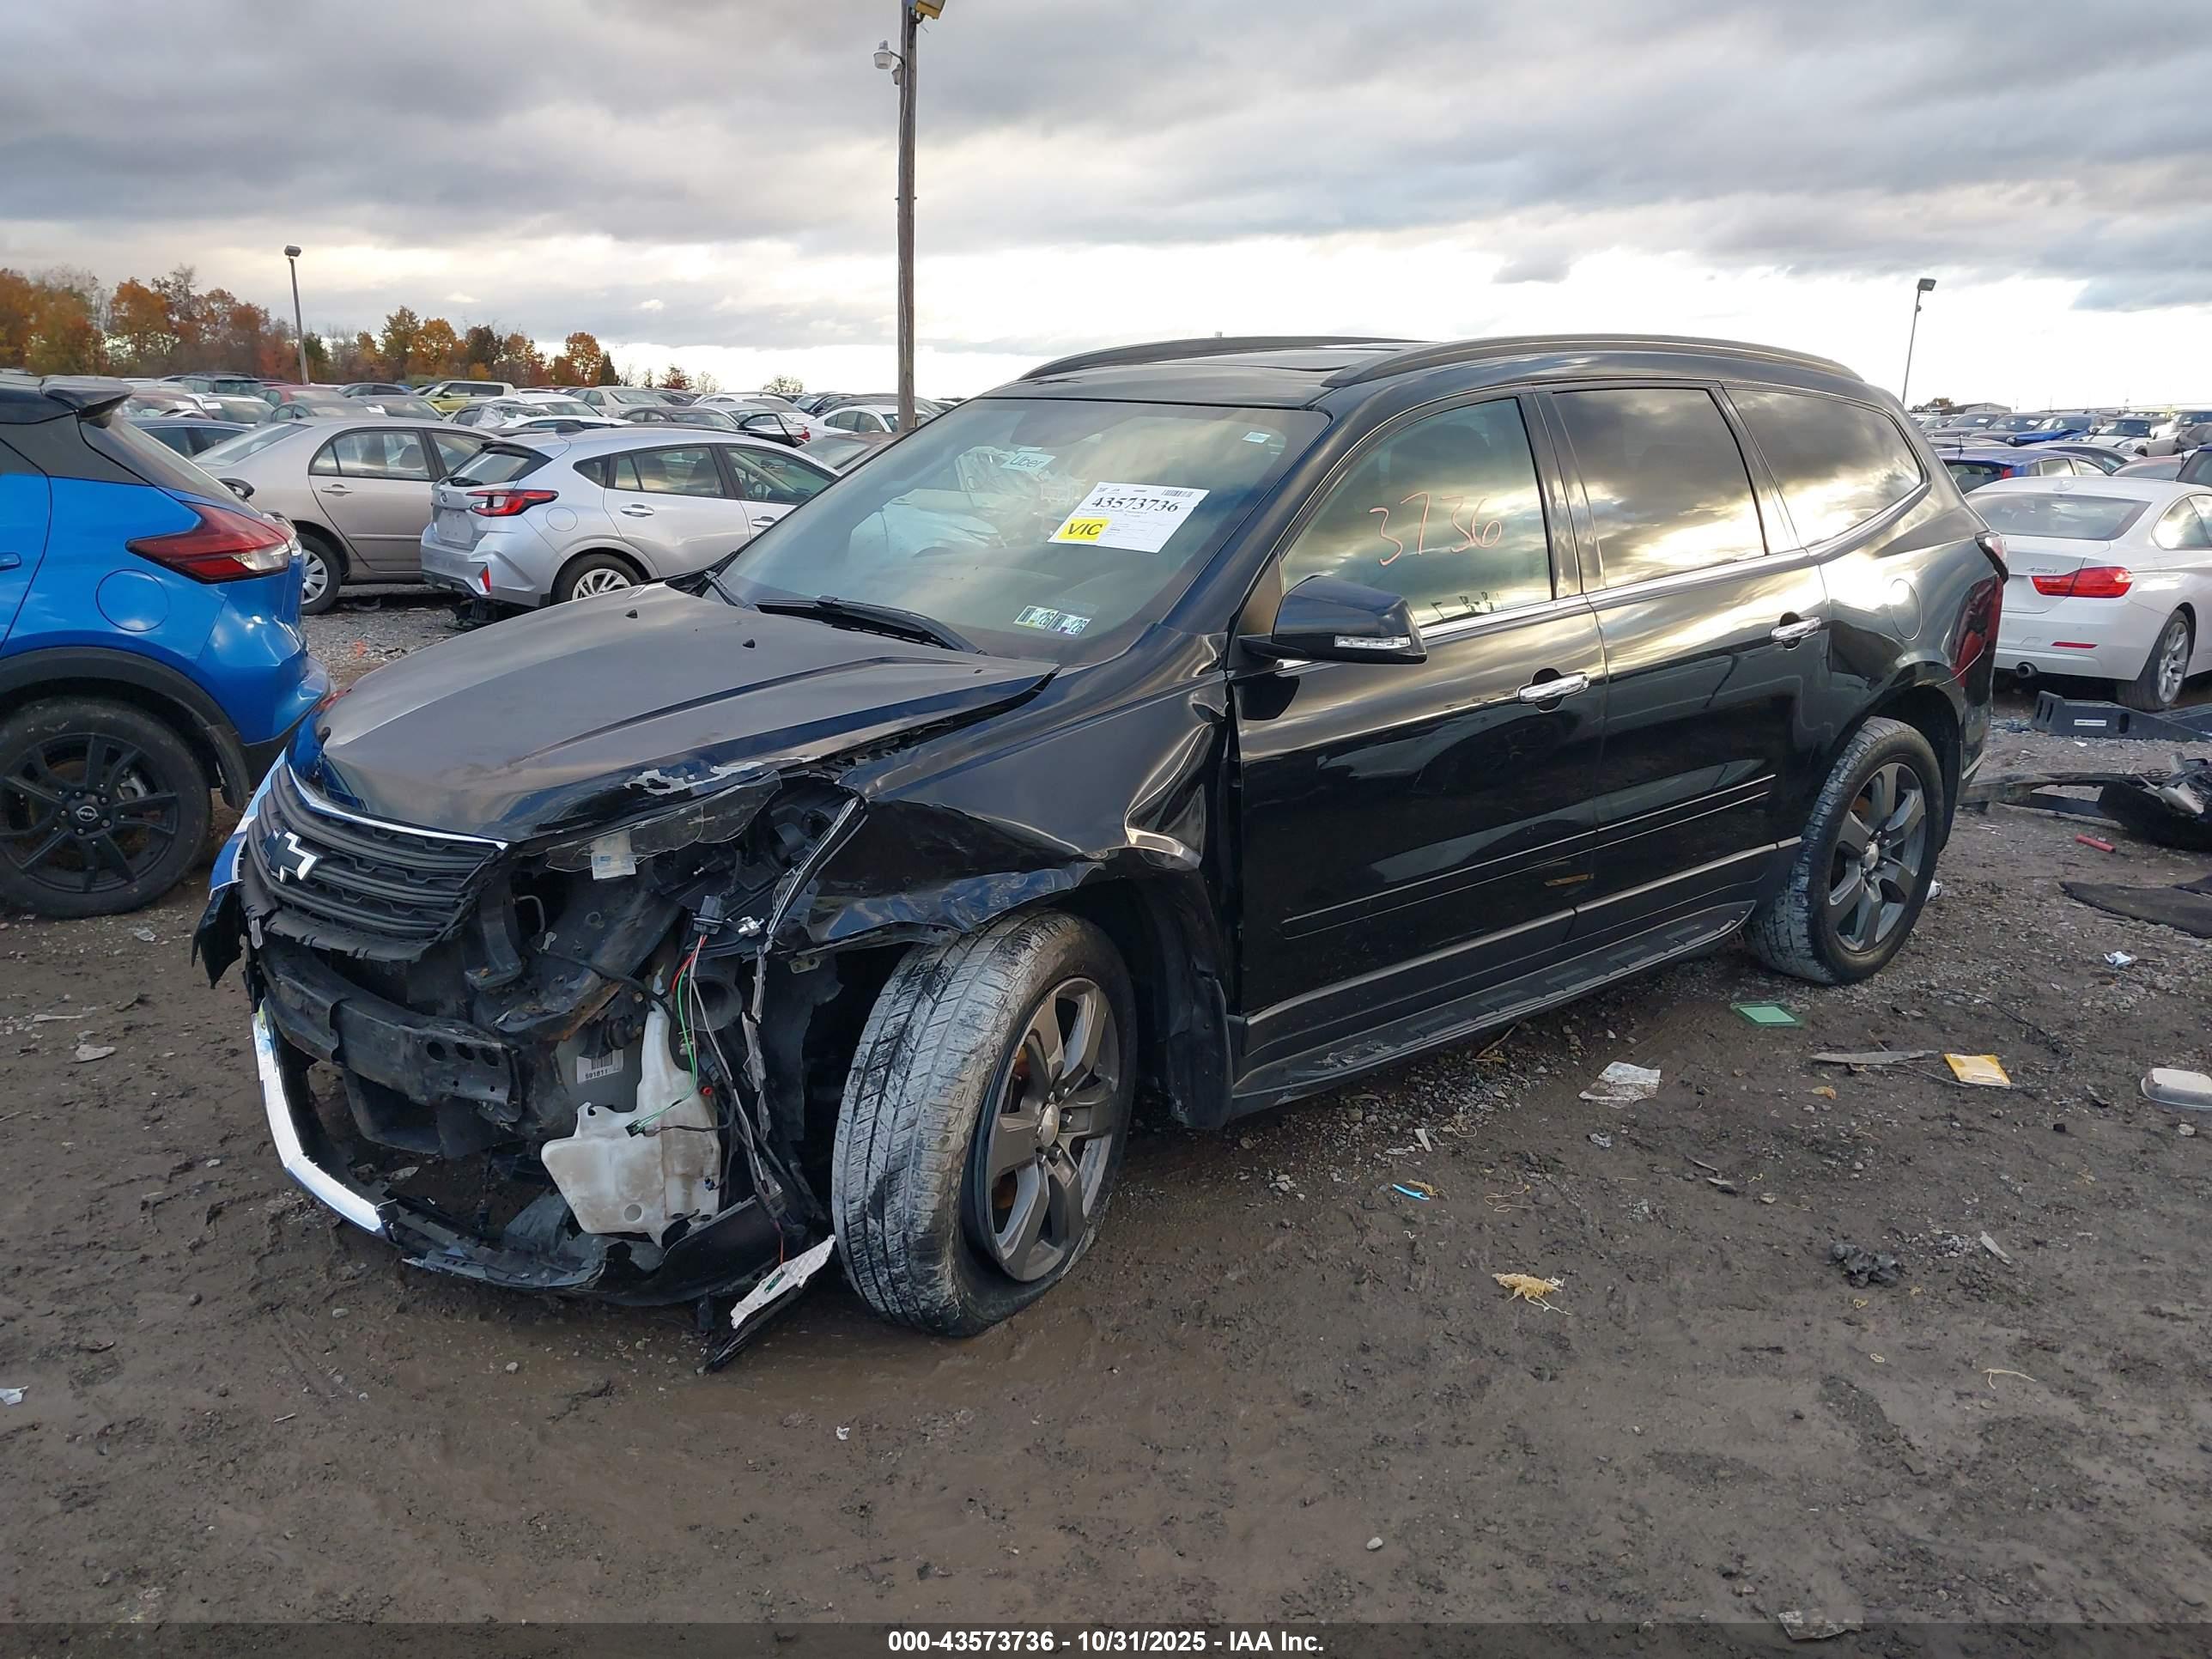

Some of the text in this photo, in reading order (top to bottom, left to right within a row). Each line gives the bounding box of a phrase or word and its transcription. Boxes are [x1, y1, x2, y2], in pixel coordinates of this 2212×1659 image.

[1010, 454, 1044, 468] Uber
[1091, 496, 1182, 513] 43573736
[1067, 523, 1103, 536] VIC
[1369, 491, 1502, 566] 3736
